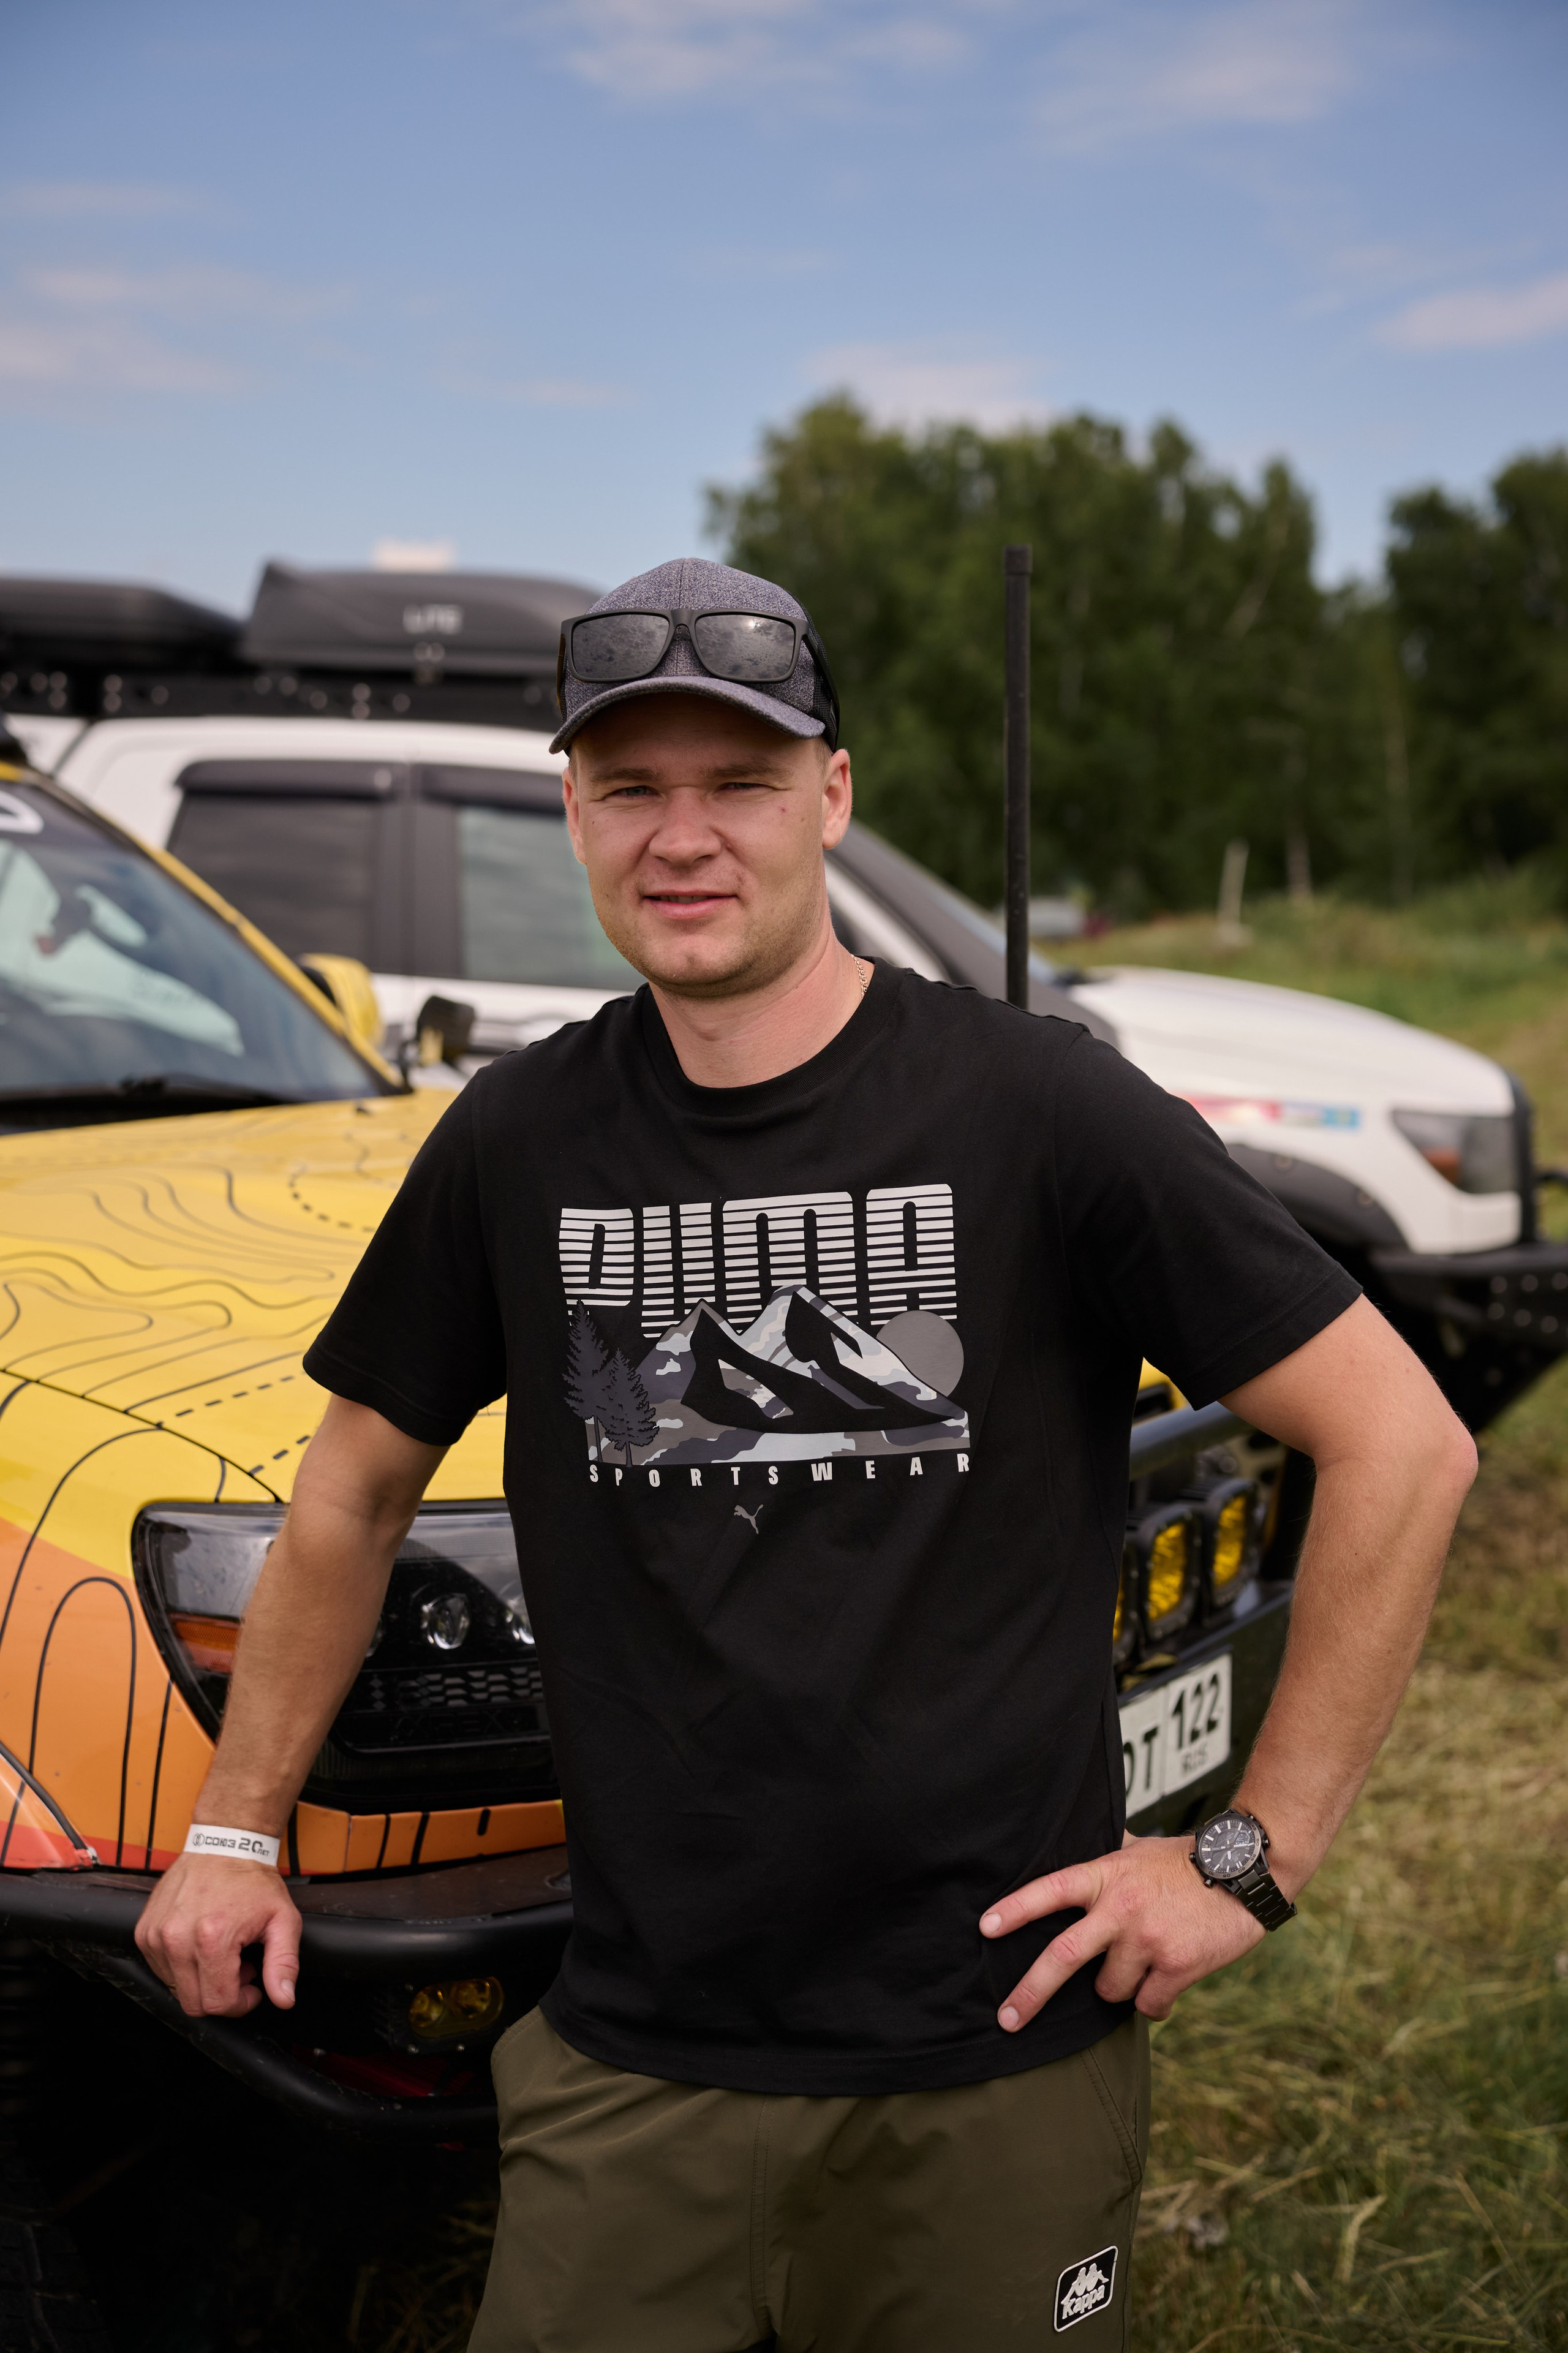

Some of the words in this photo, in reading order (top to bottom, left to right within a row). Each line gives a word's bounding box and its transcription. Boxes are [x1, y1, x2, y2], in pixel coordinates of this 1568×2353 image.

[559, 1184, 957, 1338] PUMA
[589, 1453, 970, 1487] SPORTSWEAR
[1171, 1672, 1219, 1751] 122
[205, 1837, 236, 1848] СОЮЗ
[1062, 2284, 1106, 2319] Kappa
